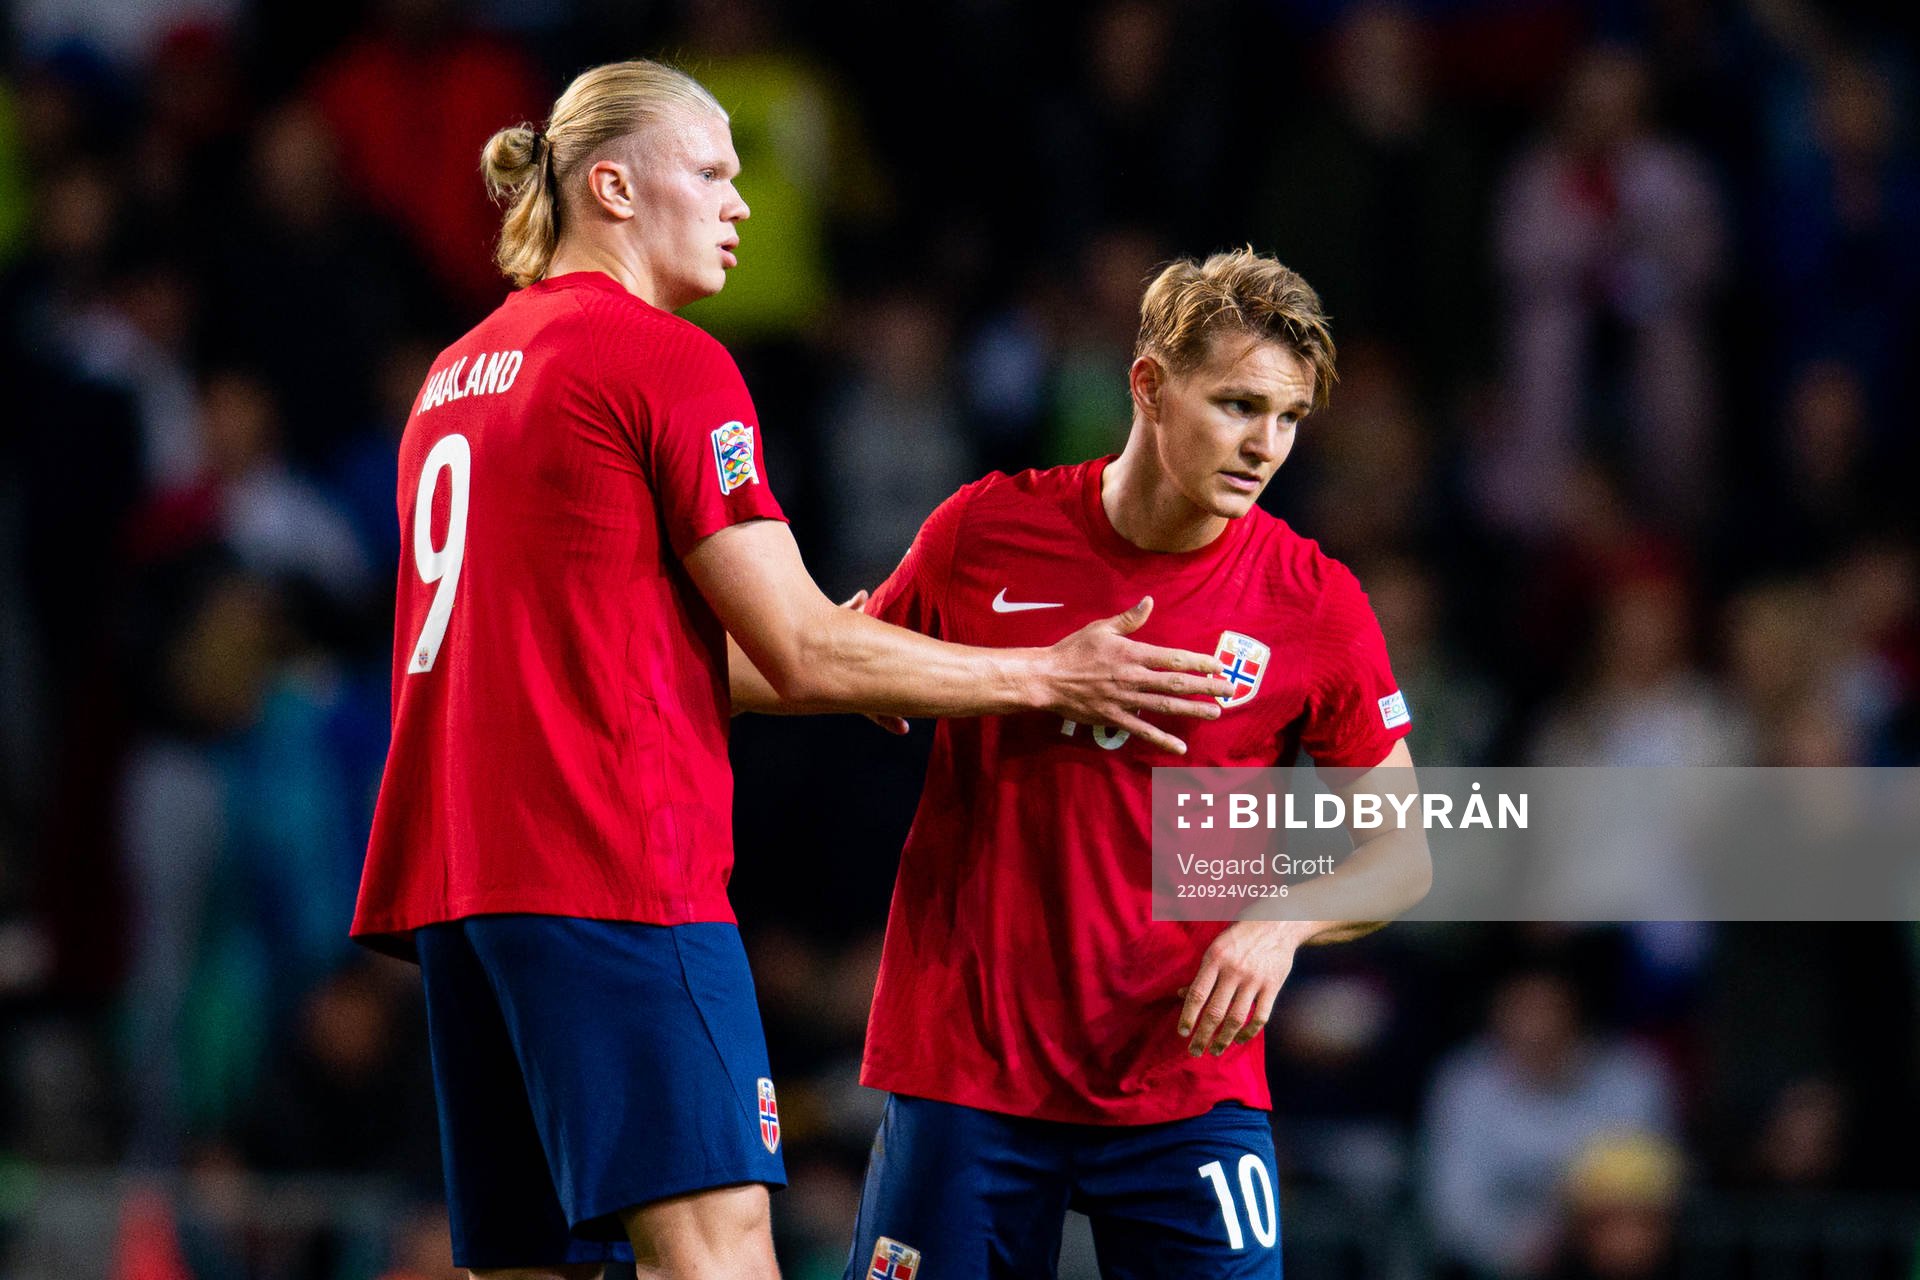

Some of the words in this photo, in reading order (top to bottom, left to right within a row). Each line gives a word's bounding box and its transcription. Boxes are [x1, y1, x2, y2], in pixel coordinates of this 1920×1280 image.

[416, 350, 524, 416] HAALAND
[407, 433, 471, 675] 9
[1198, 1153, 1277, 1250] 10
